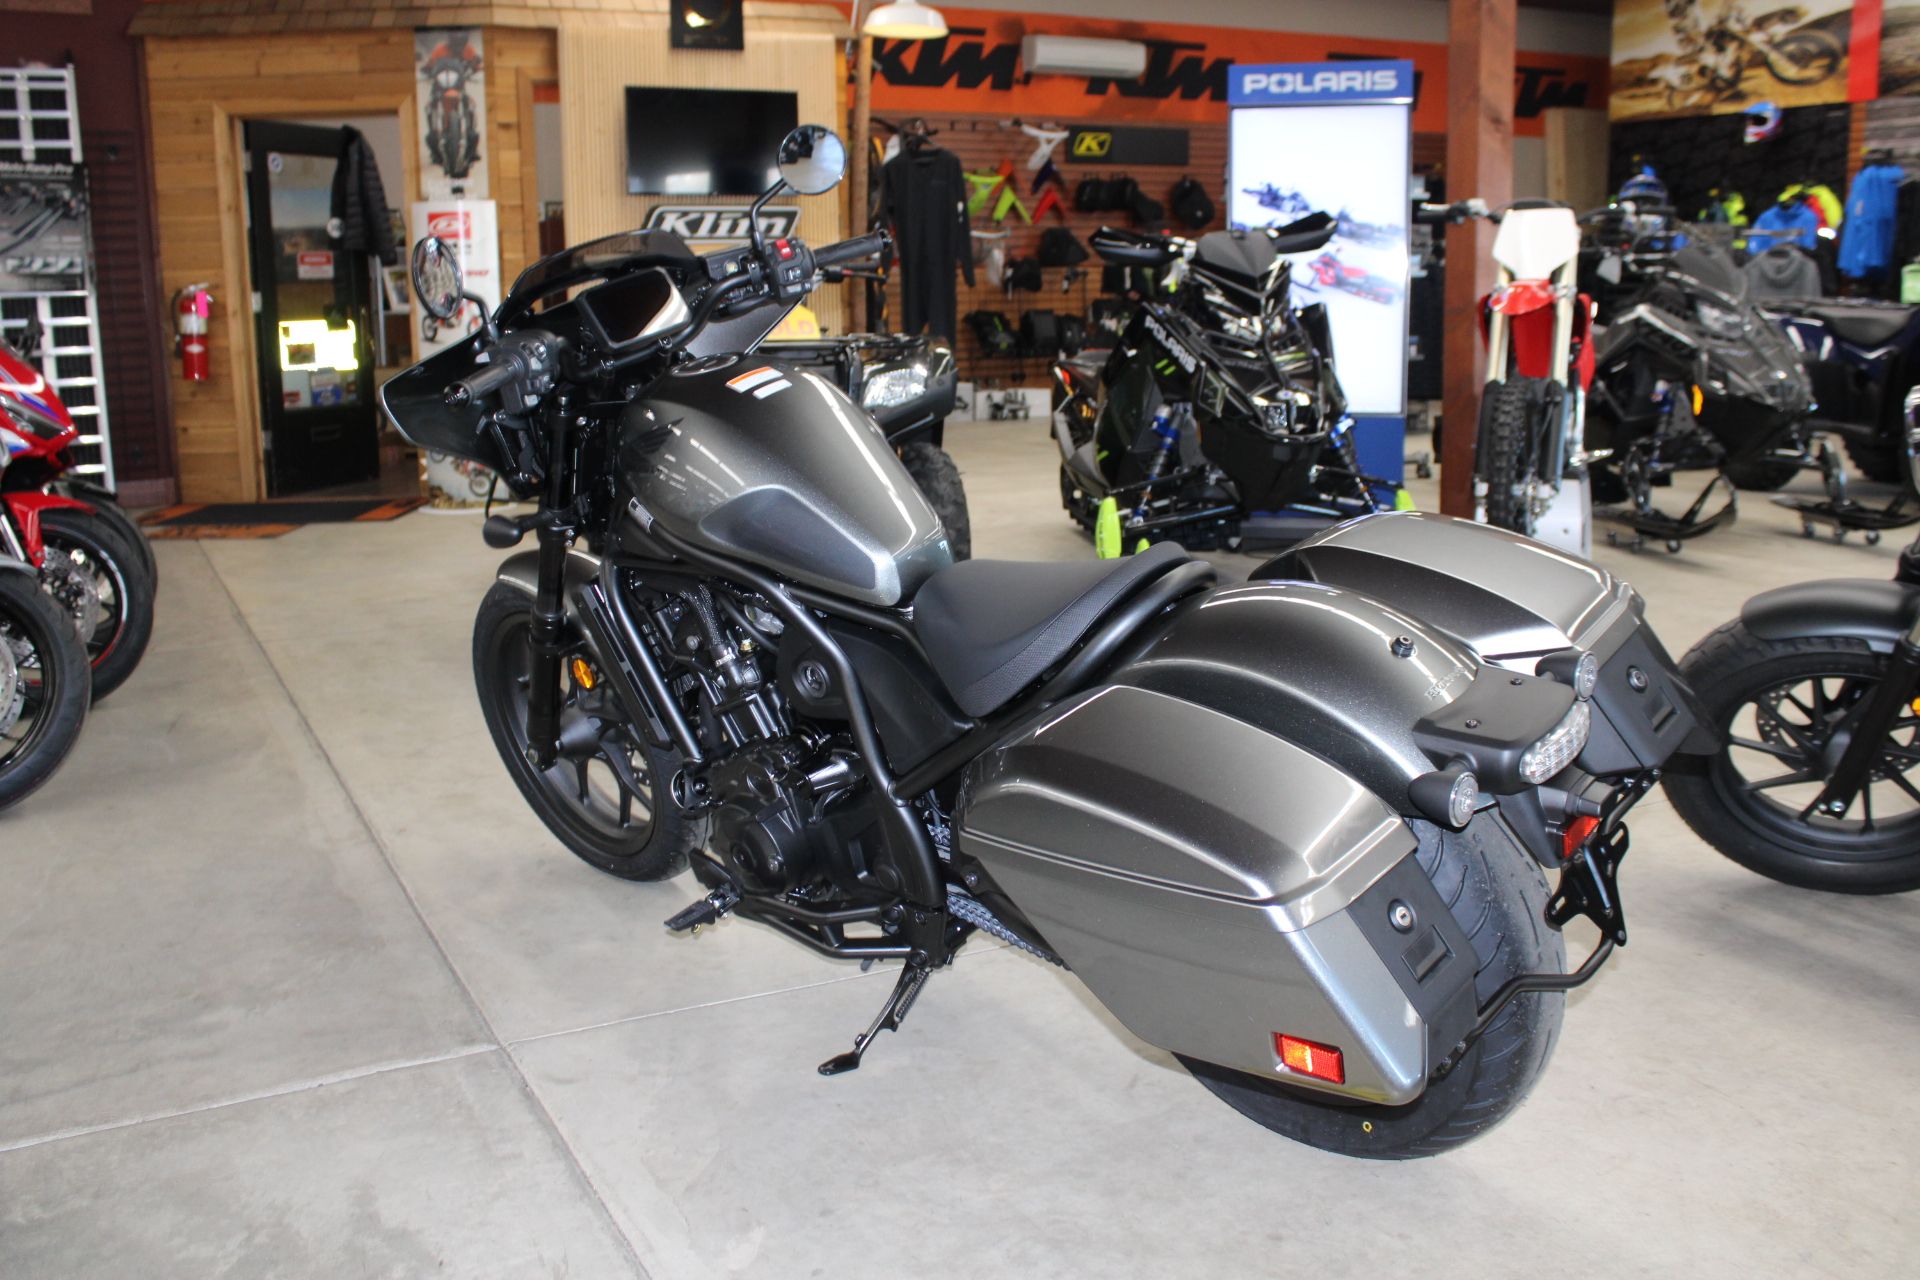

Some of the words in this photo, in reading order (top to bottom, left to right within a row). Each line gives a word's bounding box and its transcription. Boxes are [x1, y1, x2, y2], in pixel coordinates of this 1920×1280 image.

[852, 27, 1023, 91] KTM
[1242, 69, 1398, 94] POLARIS
[1144, 314, 1197, 374] POLARIS
